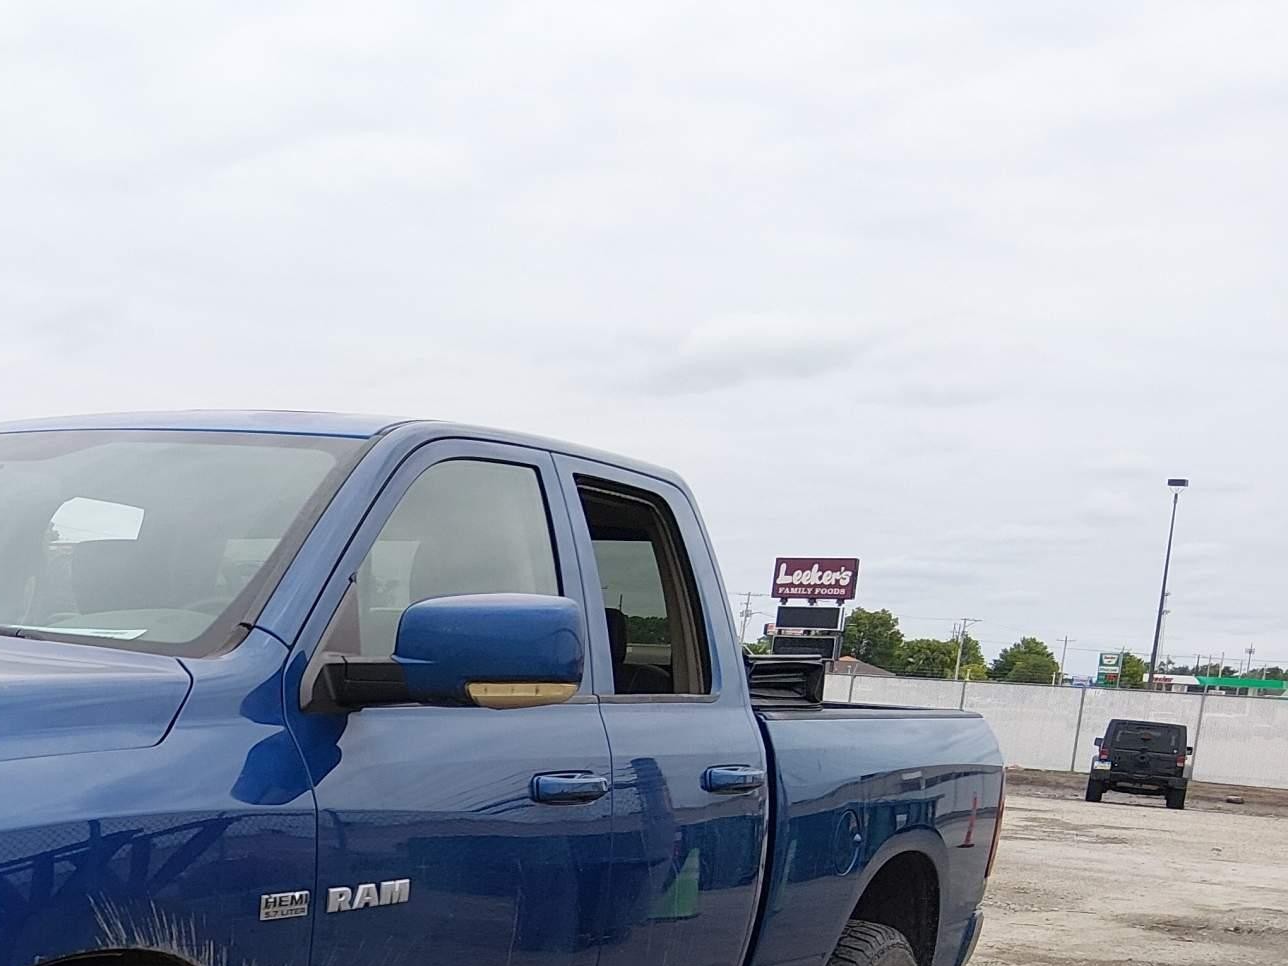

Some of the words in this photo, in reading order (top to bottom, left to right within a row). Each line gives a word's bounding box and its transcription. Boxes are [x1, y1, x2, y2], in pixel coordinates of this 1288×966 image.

[776, 563, 852, 586] Leeker's
[778, 586, 813, 595] FAMILY
[814, 587, 846, 595] FOODS
[264, 893, 309, 910] HEMI
[327, 878, 410, 913] RAM
